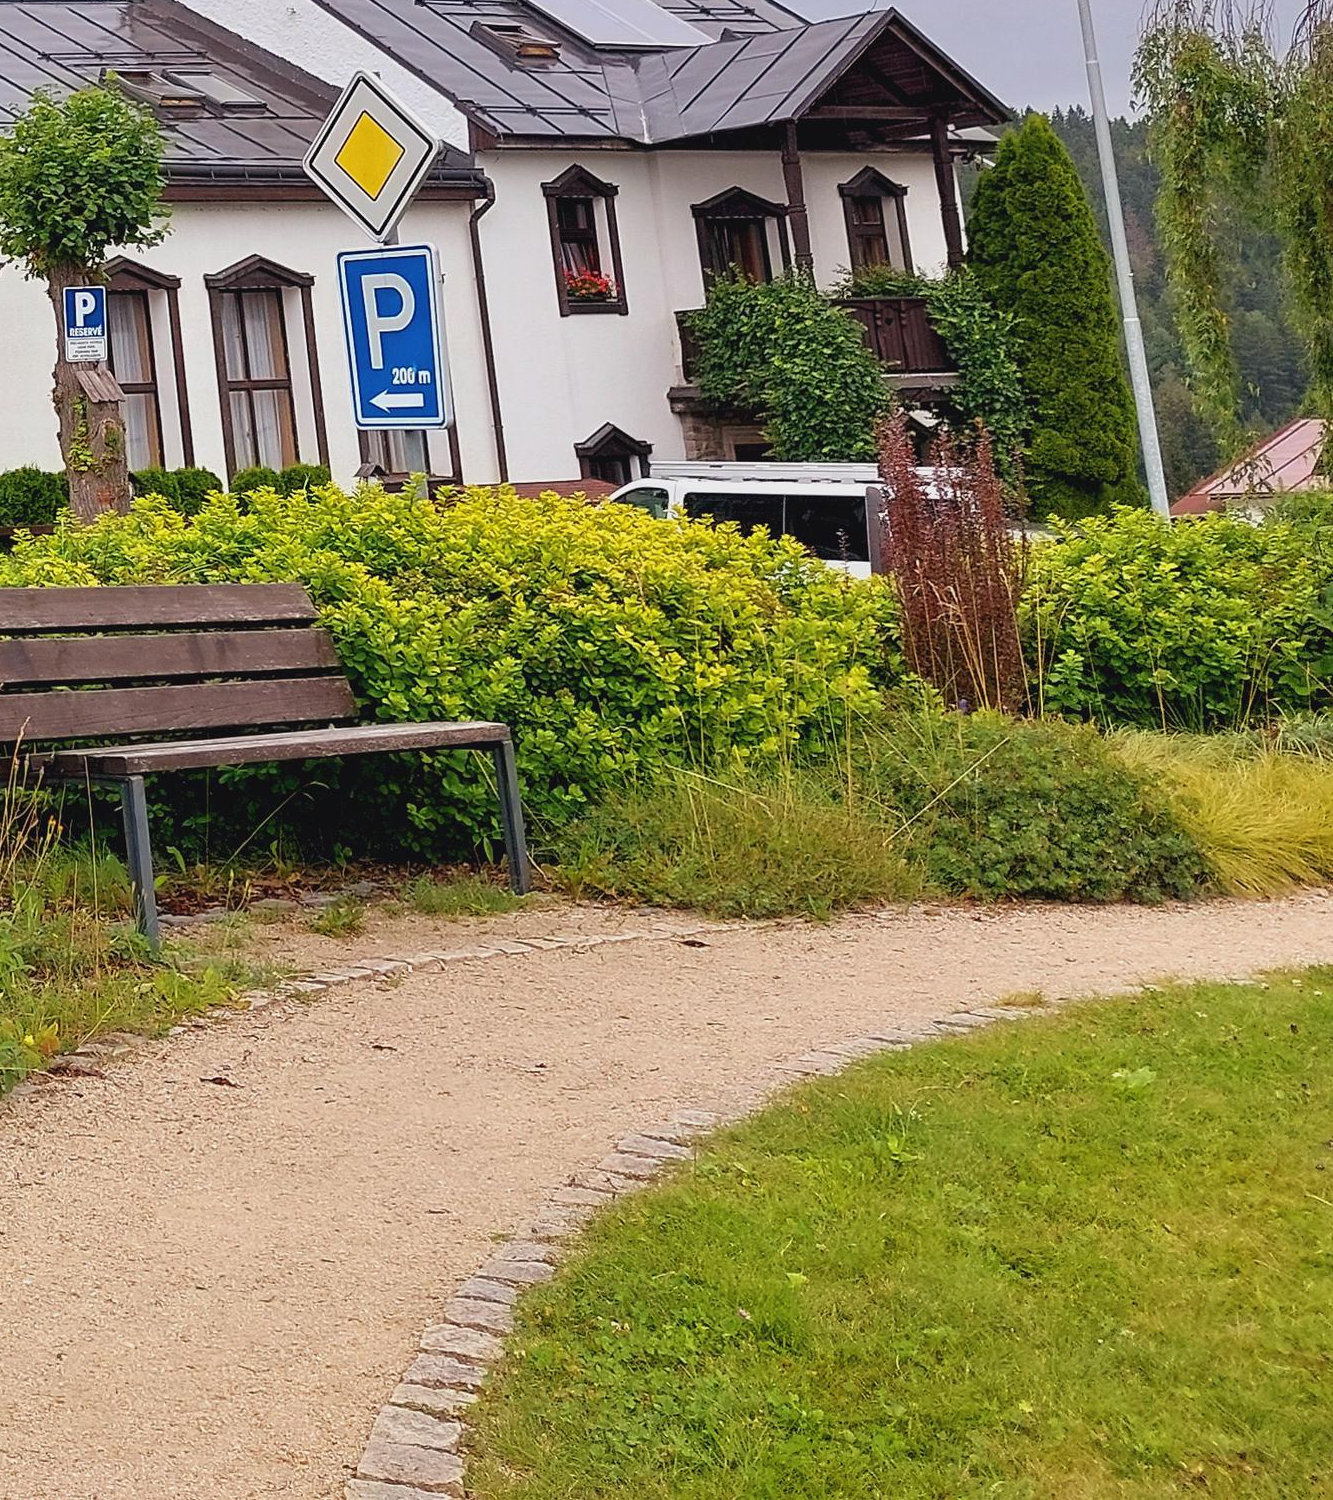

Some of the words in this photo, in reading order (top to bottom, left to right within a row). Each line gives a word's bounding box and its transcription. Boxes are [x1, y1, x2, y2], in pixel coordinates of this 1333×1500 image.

[69, 324, 103, 337] RESERVÉ
[392, 366, 416, 385] 200
[418, 368, 431, 384] m
